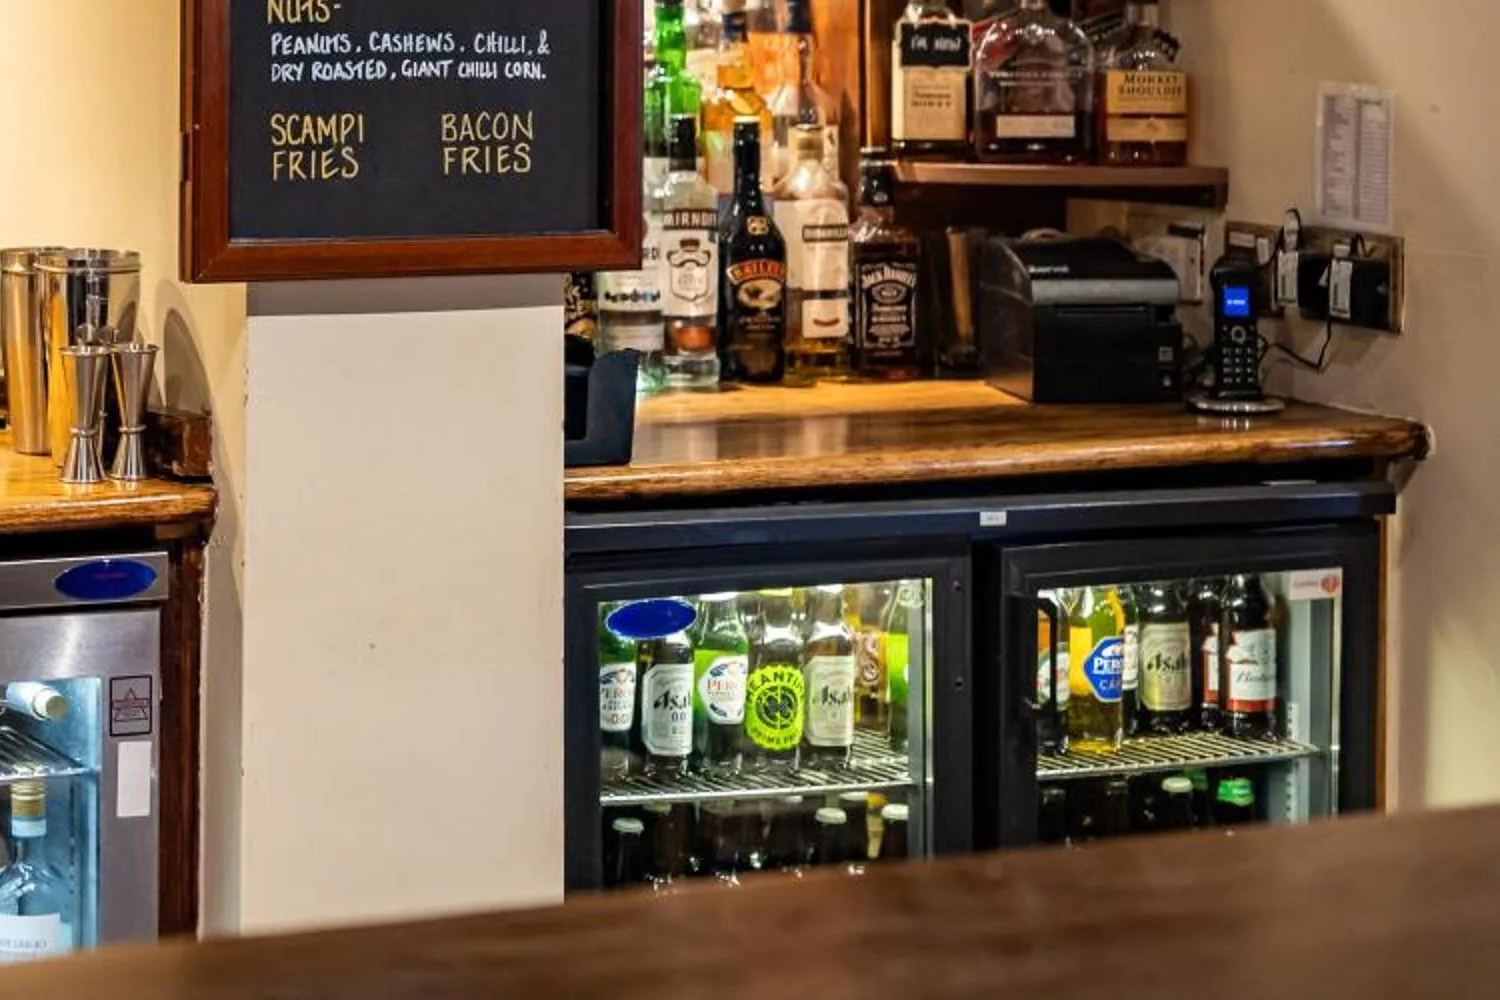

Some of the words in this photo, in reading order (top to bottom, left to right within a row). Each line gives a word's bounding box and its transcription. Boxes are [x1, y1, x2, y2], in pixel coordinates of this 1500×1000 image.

[537, 29, 551, 55] &
[271, 60, 305, 83] DRY
[401, 58, 454, 79] GIANT
[457, 60, 498, 80] CHILLI
[270, 112, 364, 146] SCAMPI
[441, 110, 533, 142] BACON
[273, 145, 360, 181] FRIES
[443, 142, 532, 175] FRIES
